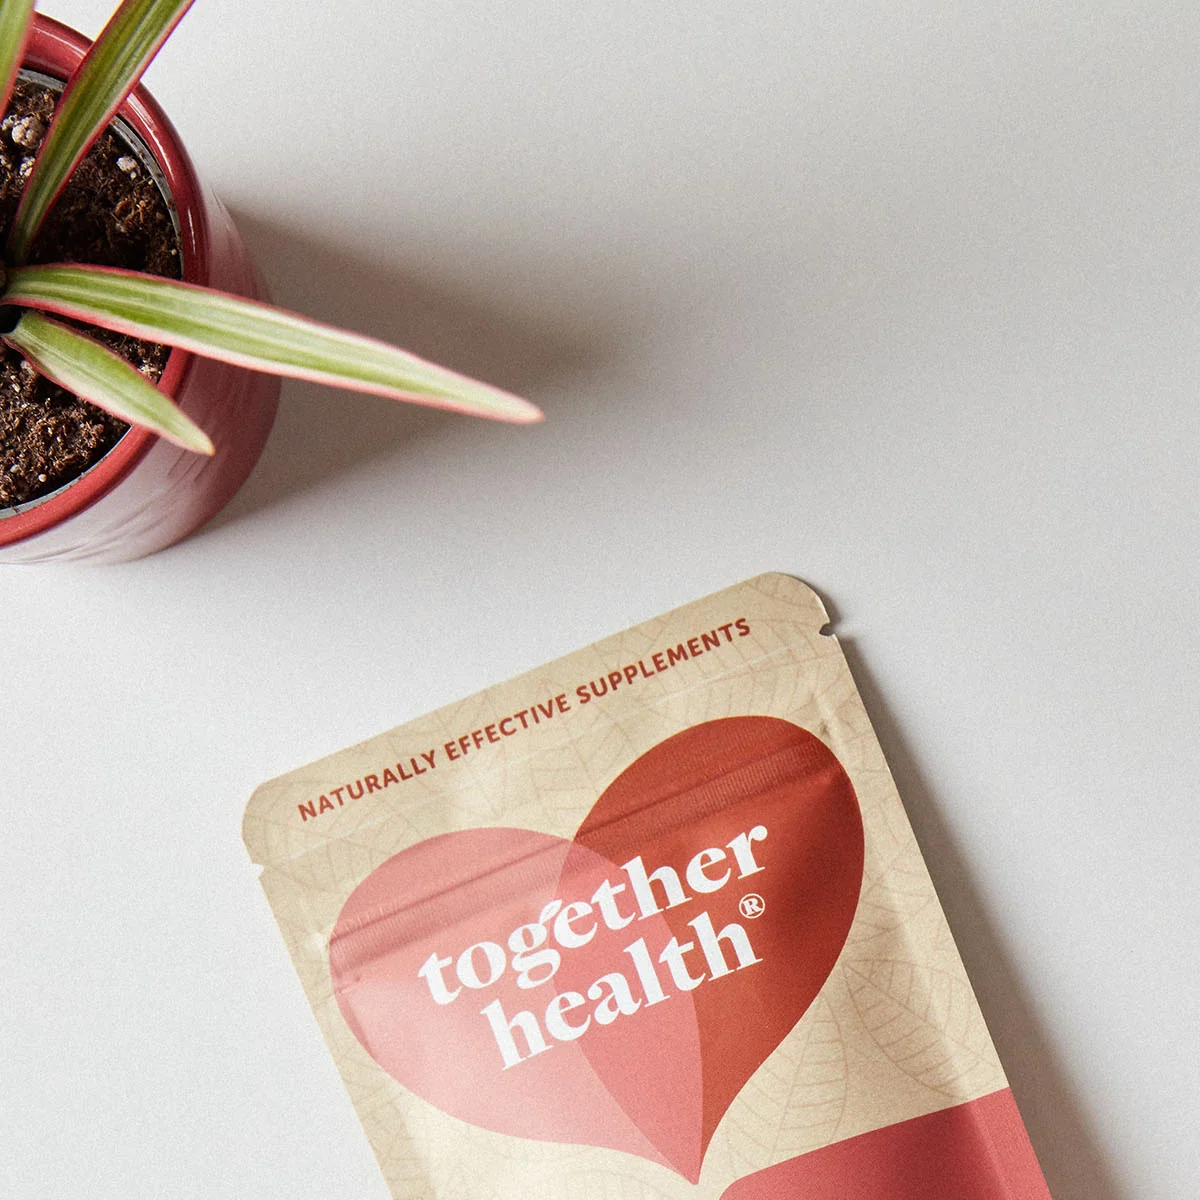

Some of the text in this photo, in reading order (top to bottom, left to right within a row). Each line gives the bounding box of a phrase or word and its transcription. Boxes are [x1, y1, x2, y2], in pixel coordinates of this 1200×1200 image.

[298, 617, 753, 822] NATURALLY EFFECTIVE SUPPLEMENTS
[417, 825, 768, 1005] together
